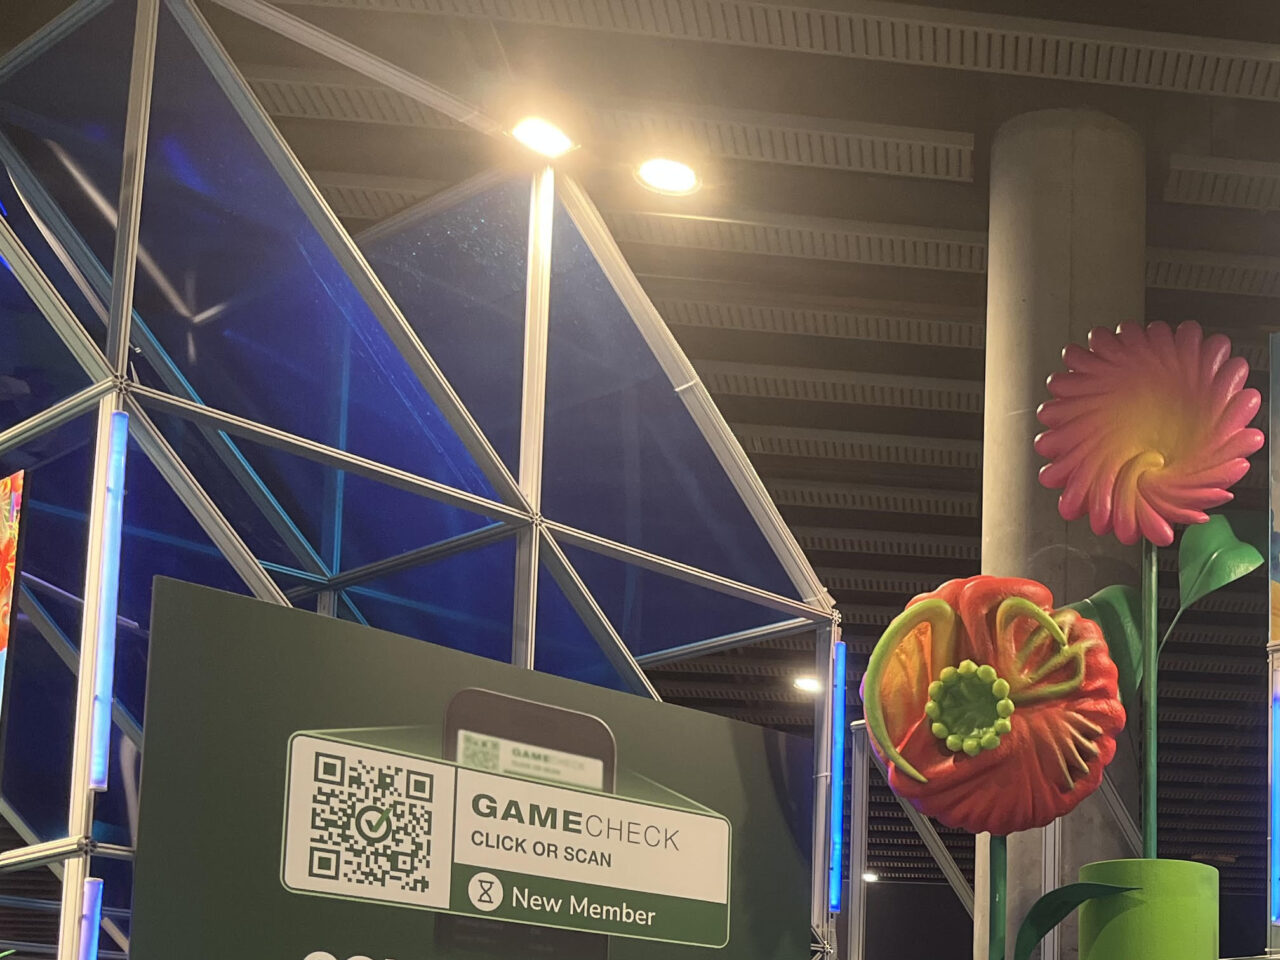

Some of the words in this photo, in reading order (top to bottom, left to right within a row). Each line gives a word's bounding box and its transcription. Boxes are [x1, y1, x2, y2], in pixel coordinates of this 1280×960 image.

[471, 793, 680, 851] GAMECHECK
[471, 830, 527, 854] CLICK
[532, 841, 558, 859] OR
[563, 846, 612, 867] SCAN
[512, 886, 562, 913] New
[569, 895, 656, 926] Member
